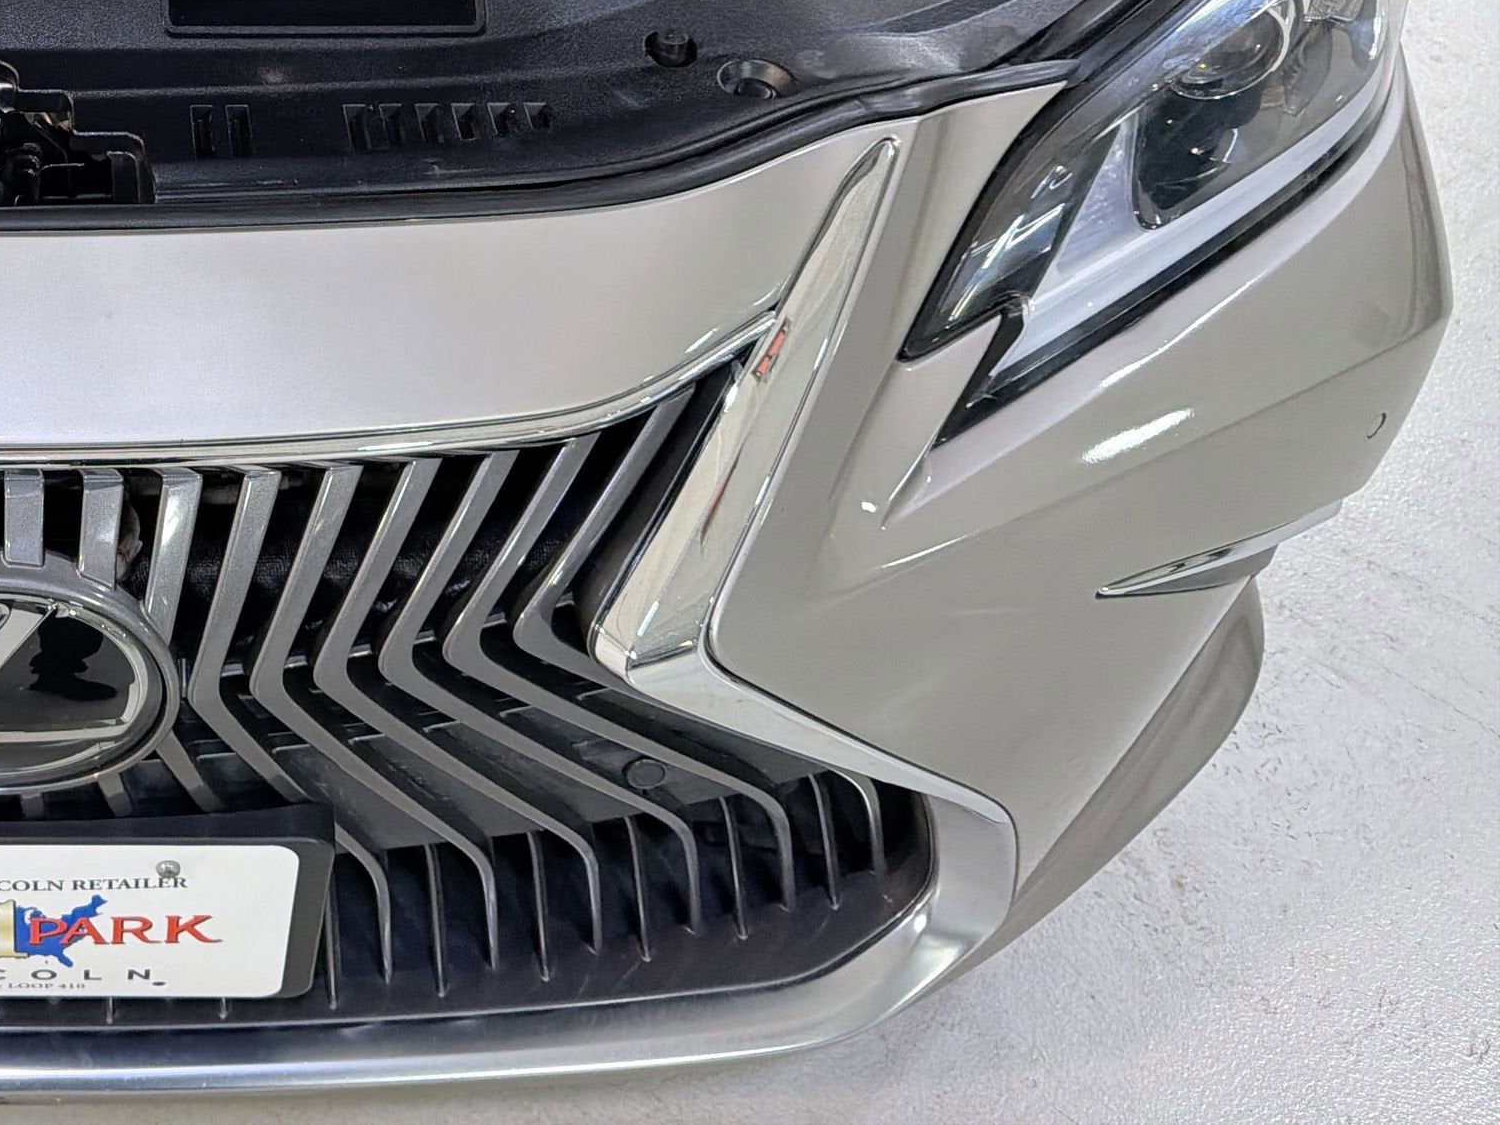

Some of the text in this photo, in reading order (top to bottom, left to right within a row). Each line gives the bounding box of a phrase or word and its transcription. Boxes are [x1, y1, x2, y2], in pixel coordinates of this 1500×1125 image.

[71, 877, 189, 892] RETAILER
[28, 914, 224, 945] PARK
[8, 982, 55, 990] LOOP
[58, 982, 86, 990] 410
